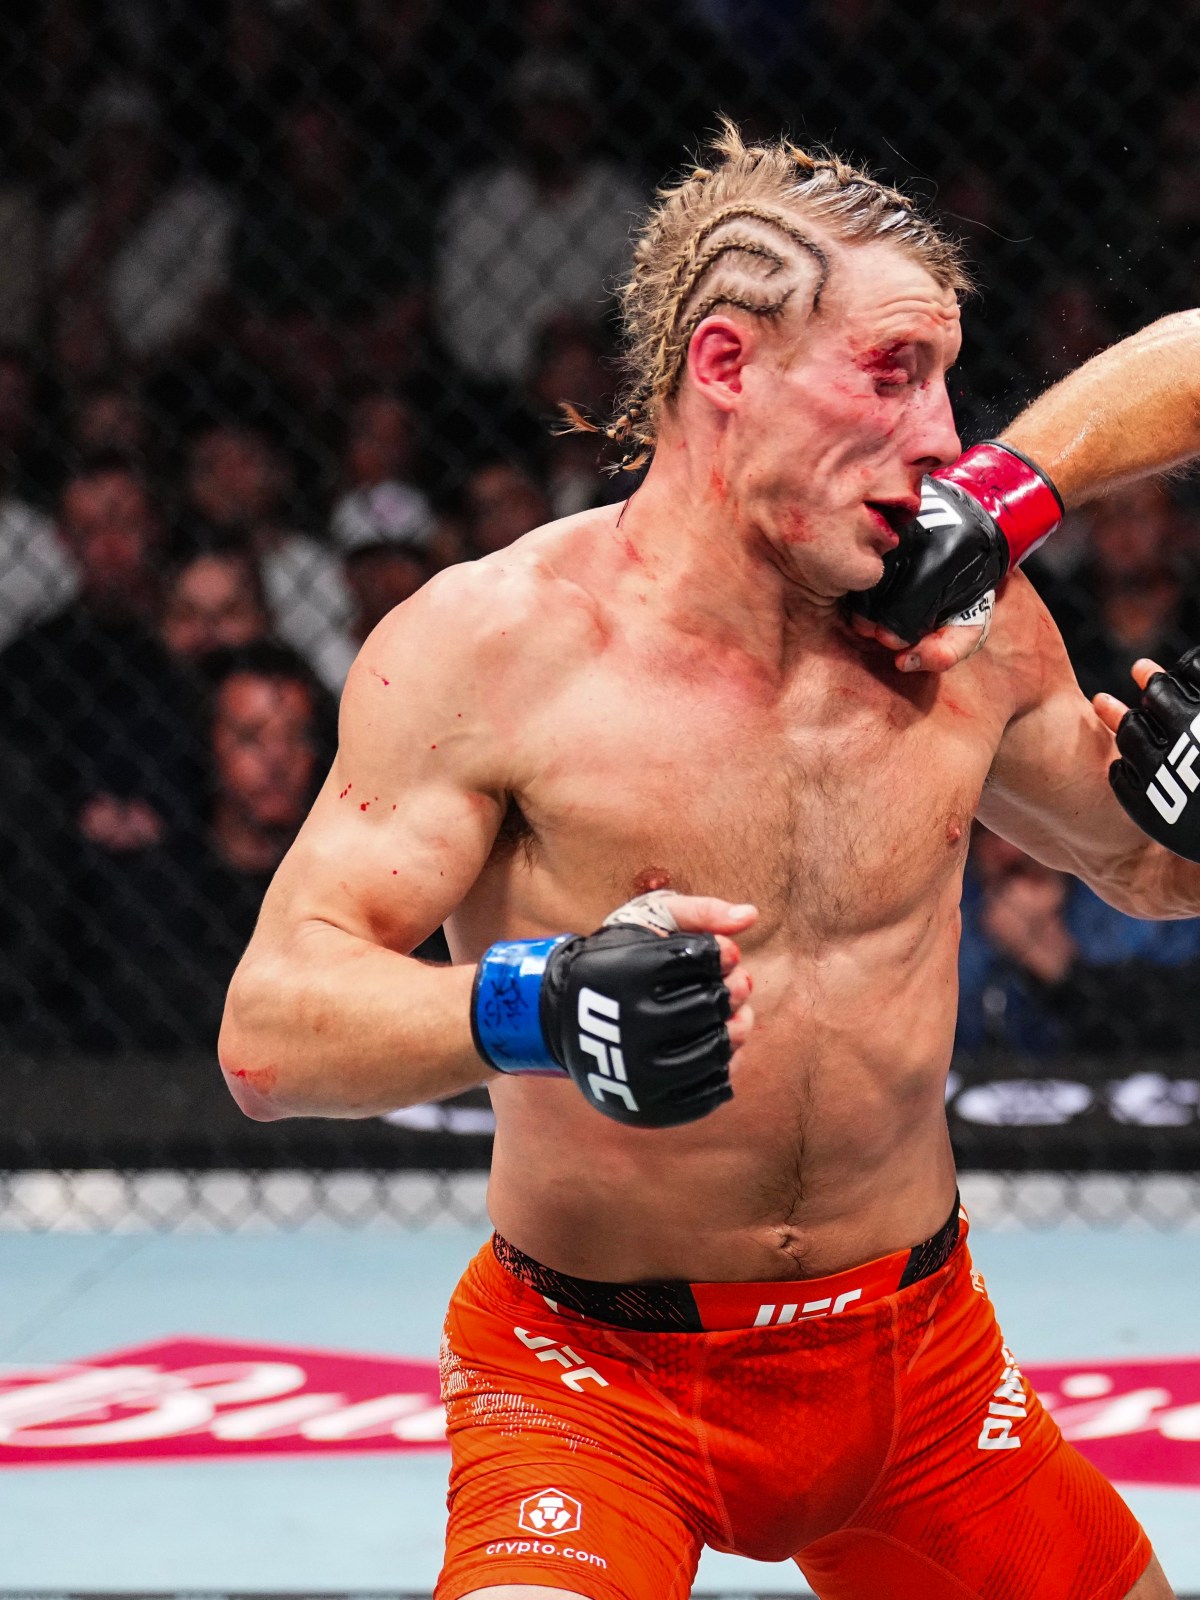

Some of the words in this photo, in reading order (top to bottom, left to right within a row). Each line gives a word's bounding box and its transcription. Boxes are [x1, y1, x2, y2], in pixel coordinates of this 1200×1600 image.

[578, 987, 640, 1112] UFC
[514, 1326, 610, 1393] UFC
[486, 1540, 608, 1570] crypto.com
